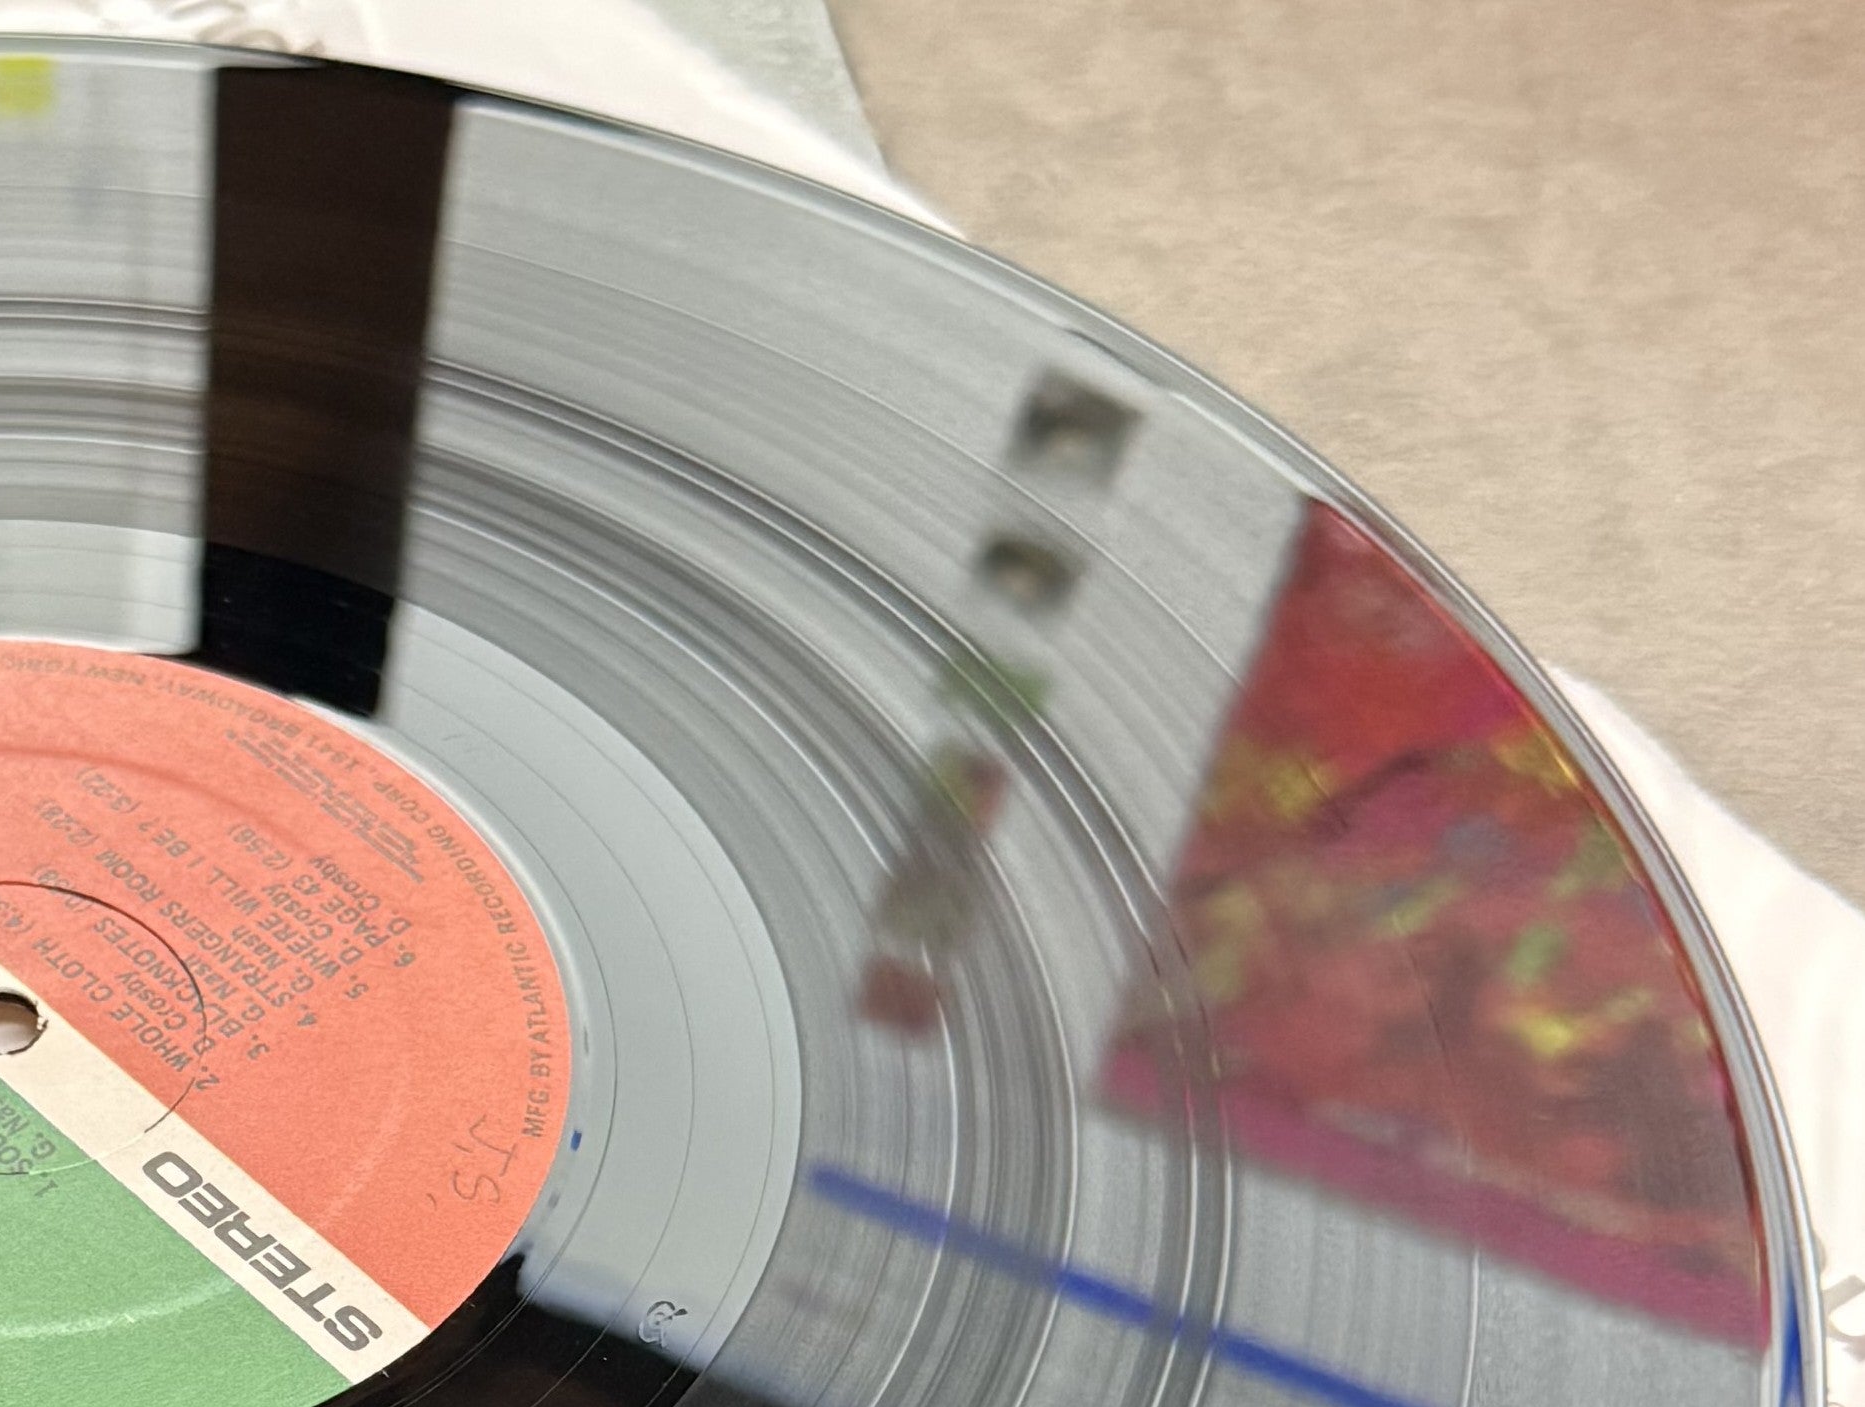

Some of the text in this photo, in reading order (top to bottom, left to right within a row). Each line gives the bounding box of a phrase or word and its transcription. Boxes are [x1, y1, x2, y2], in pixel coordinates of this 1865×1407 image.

[91, 847, 167, 903] ROOM
[198, 866, 266, 915] WILL
[289, 872, 325, 898] 43
[304, 851, 386, 914] Crosby
[424, 823, 518, 934] RECORDING
[257, 879, 338, 942] Crosby
[318, 894, 392, 949] PAGE
[27, 935, 118, 1004] CLOTH
[91, 915, 246, 1038] BLACKNOTES
[156, 899, 296, 1009] STRANGERS
[175, 952, 240, 1000] Nash
[225, 923, 290, 970] Nash
[255, 911, 346, 979] WHERE
[111, 967, 191, 1032] Crosby
[505, 940, 549, 1041] ATLANTIC
[109, 1002, 198, 1072] WHOLE
[531, 1047, 554, 1075] BY
[20, 1132, 59, 1160] G.
[141, 1150, 384, 1353] STEREO
